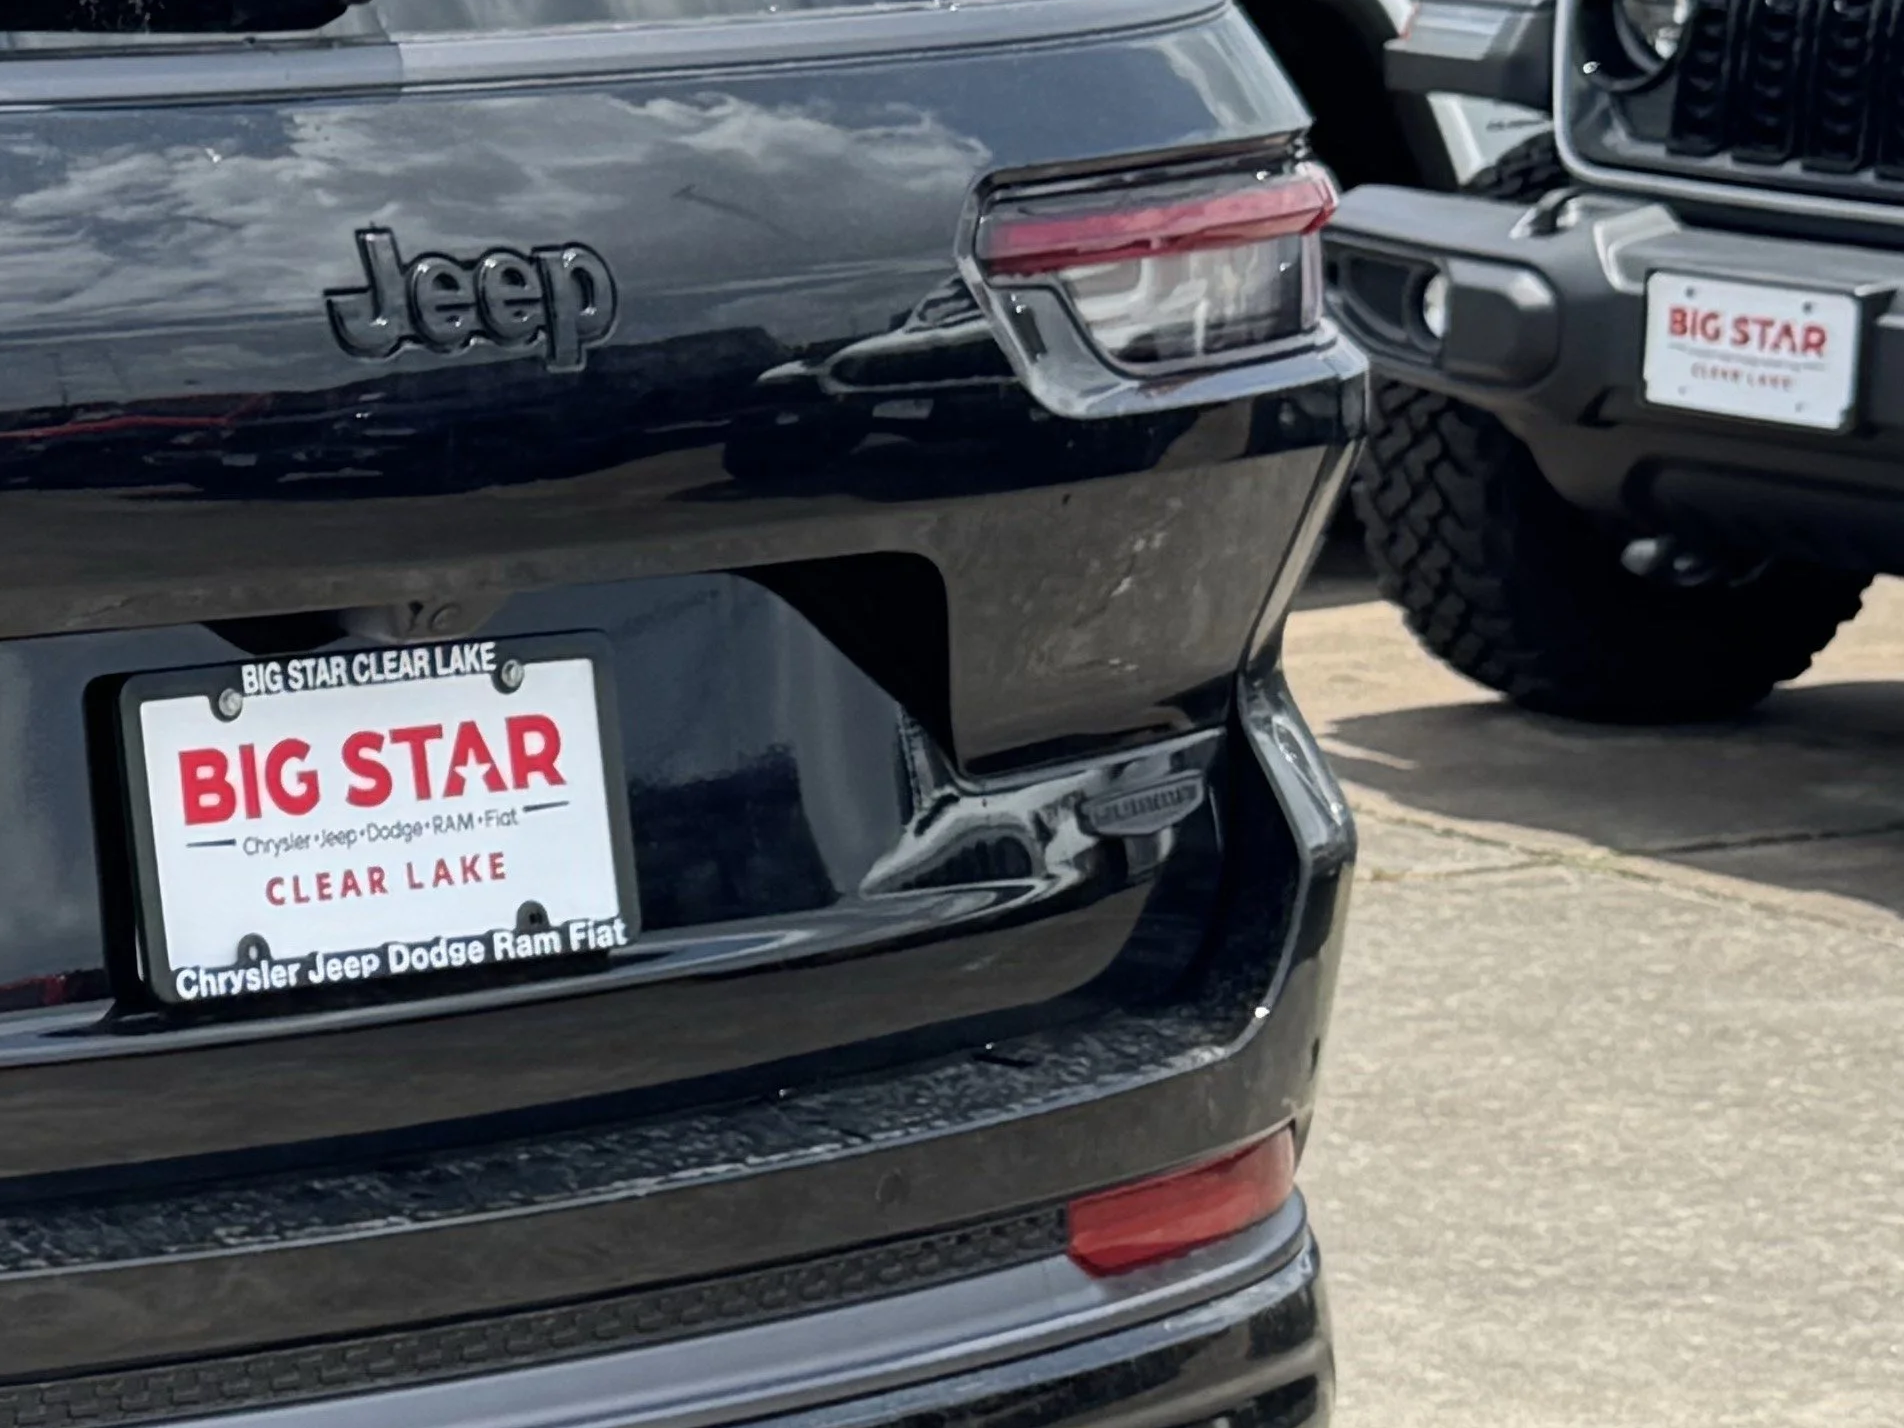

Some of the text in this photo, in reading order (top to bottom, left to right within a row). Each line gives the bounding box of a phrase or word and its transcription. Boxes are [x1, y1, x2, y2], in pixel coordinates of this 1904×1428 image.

[323, 225, 619, 372] Jeep
[1668, 306, 1721, 342] BIG
[1731, 315, 1828, 358] STAR
[242, 642, 497, 694] BIG STAR CLEAR LAKE
[178, 714, 566, 825] BIG STAR
[265, 852, 506, 906] CLEAR LAKE
[176, 917, 628, 1001] Chrysler Jeep Dodge Ram Fiat
